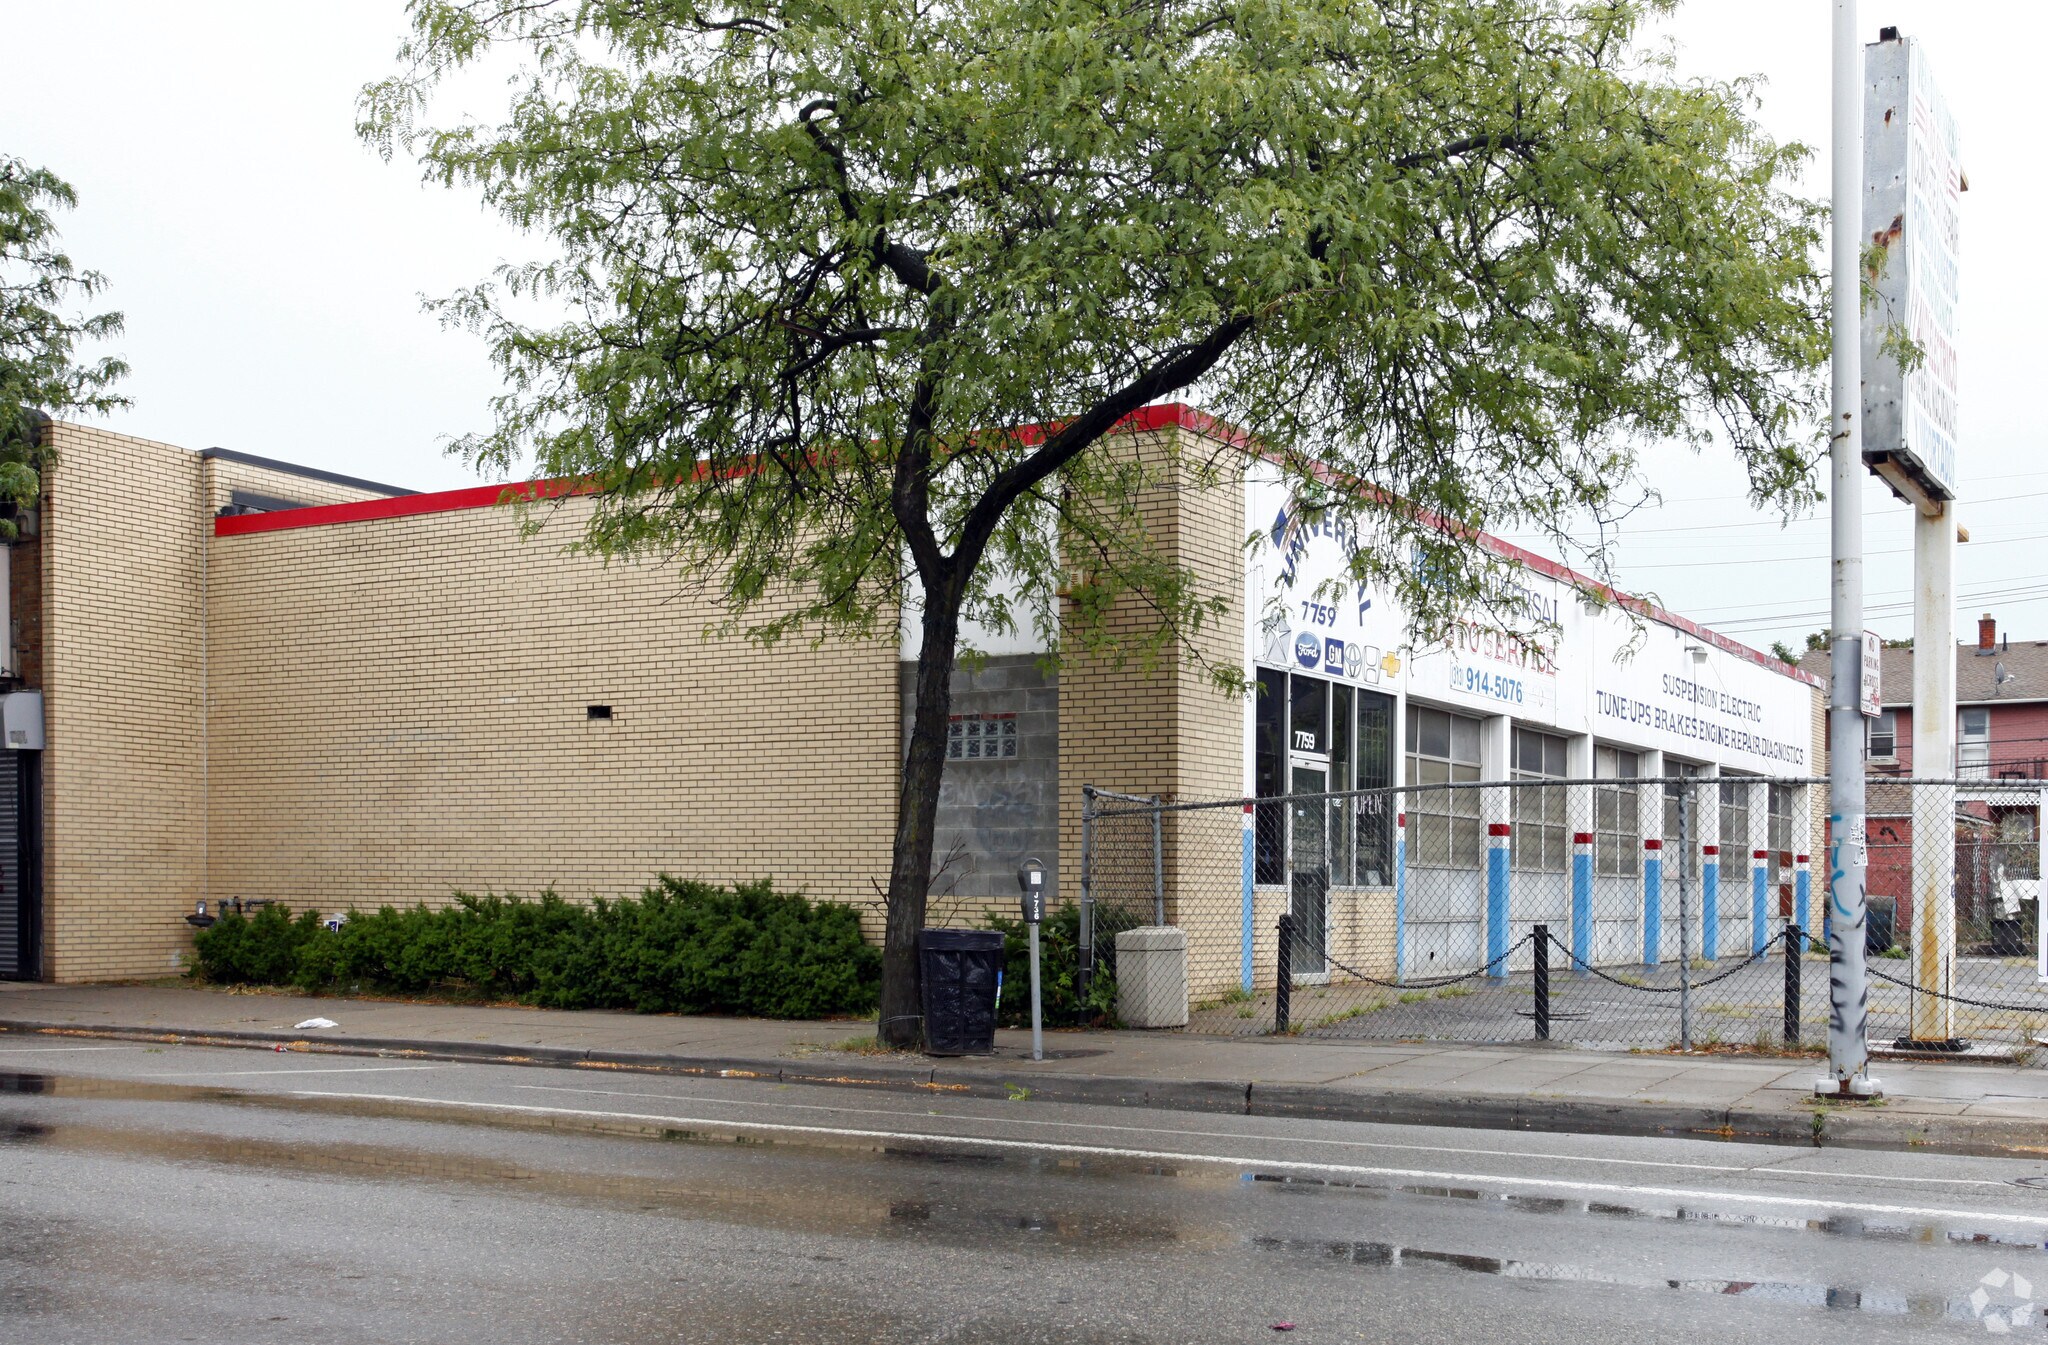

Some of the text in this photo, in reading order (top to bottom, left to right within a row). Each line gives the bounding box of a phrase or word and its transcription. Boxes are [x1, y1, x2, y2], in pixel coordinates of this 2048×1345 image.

[1301, 601, 1337, 627] 7759
[1298, 642, 1319, 658] Ford
[1328, 644, 1343, 665] GM
[1863, 654, 1879, 672] PARKING
[1466, 666, 1523, 703] 914-5076
[1662, 673, 1761, 723] SUSPENSION ELECTRIC
[1295, 731, 1315, 750] 7759
[1654, 706, 1698, 739] BRAKES
[1699, 720, 1730, 747] ENGINE
[1731, 730, 1761, 755] REPAIR
[1761, 738, 1803, 765] DIAGNOSTICS
[1355, 794, 1382, 815] OPEN
